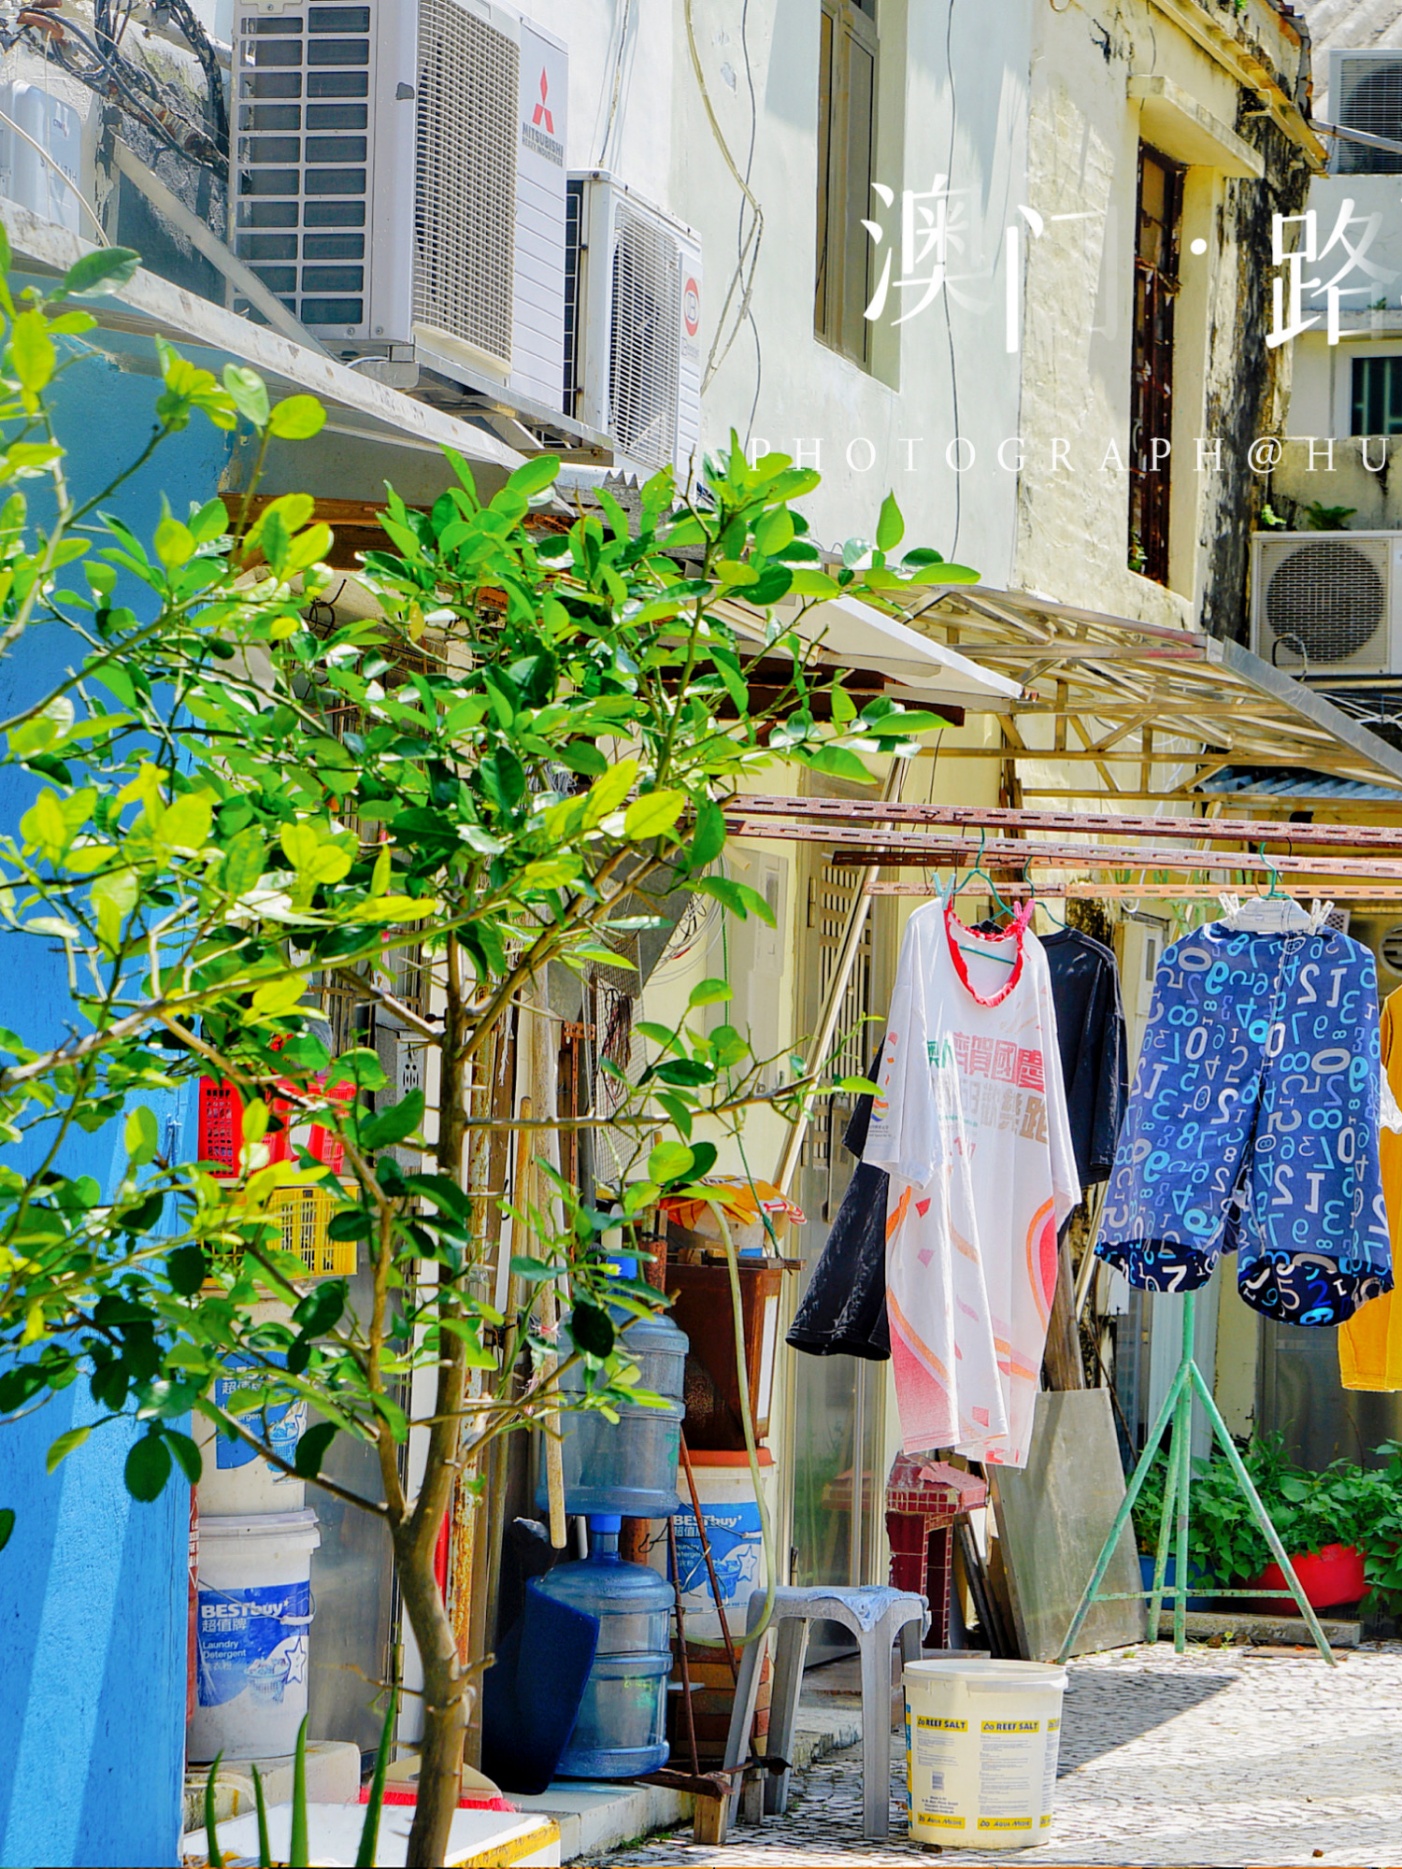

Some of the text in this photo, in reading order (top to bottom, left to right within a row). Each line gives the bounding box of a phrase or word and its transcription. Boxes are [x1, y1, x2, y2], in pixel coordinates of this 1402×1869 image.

[522, 122, 564, 156] MITSUBISHI
[202, 1618, 247, 1633] 超值牌
[203, 1640, 239, 1650] Laundry
[203, 1649, 246, 1660] Detergent
[925, 1717, 942, 1727] REEF
[944, 1720, 966, 1730] SALT
[996, 1722, 1017, 1731] REEF
[1018, 1721, 1039, 1731] SALT
